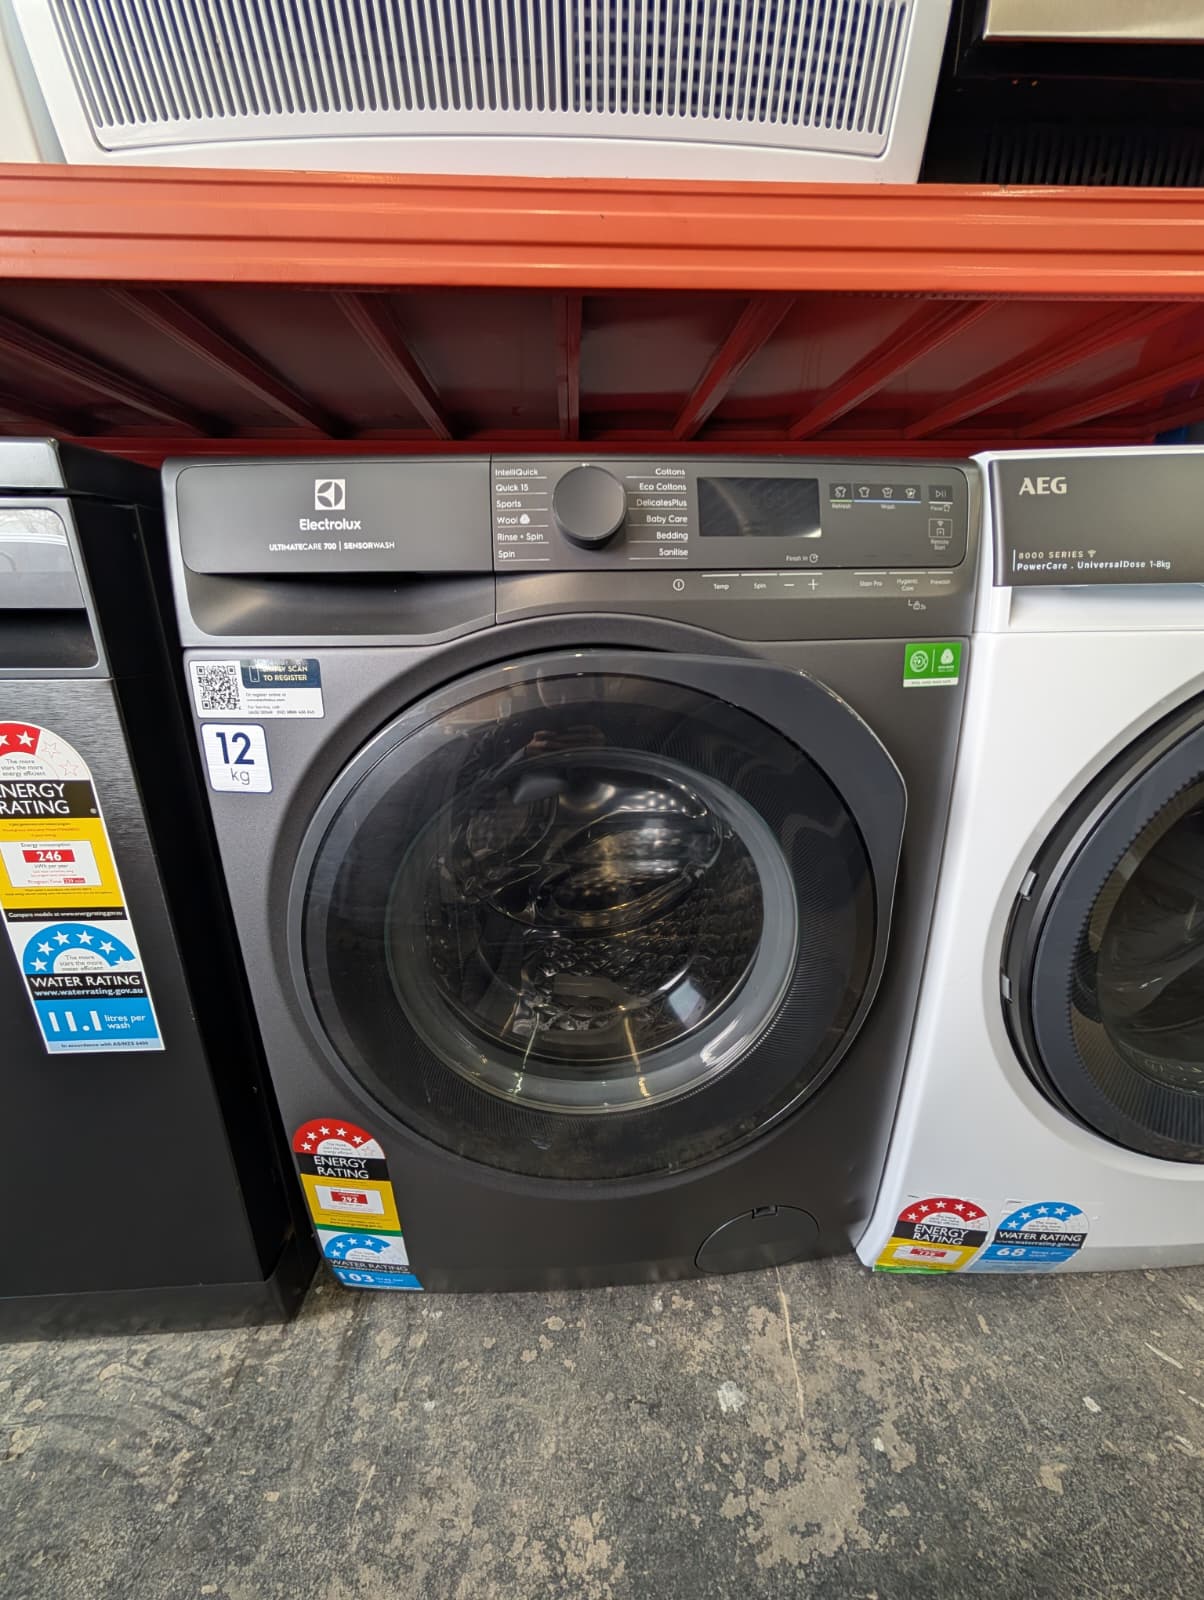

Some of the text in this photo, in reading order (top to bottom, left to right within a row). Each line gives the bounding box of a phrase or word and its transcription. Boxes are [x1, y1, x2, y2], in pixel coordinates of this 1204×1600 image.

[495, 468, 538, 476] IntelliQuick
[655, 468, 686, 476] Cottons
[495, 483, 529, 492] Quick 15
[639, 482, 687, 491] Eco Cottons
[1018, 476, 1067, 495] AEG
[496, 500, 522, 509] Sports
[636, 499, 688, 507] DelicatesPlus
[299, 517, 362, 531] Electrolux
[496, 516, 519, 525] Wool
[646, 514, 688, 525] Baby Care
[497, 533, 518, 541] Rinse
[526, 532, 544, 542] Spin
[656, 531, 689, 542] Bedding
[268, 541, 395, 552] ULTIMATECARE 700 SENSORWASH
[498, 550, 516, 559] Spin
[658, 548, 689, 557] Sanitise
[1018, 550, 1084, 560] 8000 SERIES
[1016, 559, 1171, 571] PowerCare UniversalDose 1-8kg
[713, 583, 730, 591] Temp
[753, 582, 767, 590] Spin
[287, 664, 309, 673] SCAN
[215, 731, 255, 765] 12
[230, 767, 250, 785] kg
[0, 783, 65, 798] NERGY
[0, 800, 70, 815] RATING
[36, 850, 62, 861] 246
[8, 911, 33, 919] Compare
[30, 975, 141, 988] WATER RATING
[34, 987, 144, 997] www.waterrating.gov.au
[48, 1010, 103, 1033] 11.1
[104, 1014, 146, 1023] litres per
[313, 1155, 367, 1169] ENERGY
[316, 1166, 370, 1179] RATING
[914, 1223, 969, 1239] ENERGY
[999, 1231, 1082, 1242] WATER RATING
[912, 1232, 965, 1245] RATING
[996, 1247, 1026, 1257] 68
[329, 1259, 368, 1269] WATER
[368, 1262, 409, 1272] RATING
[338, 1271, 375, 1283] 103
